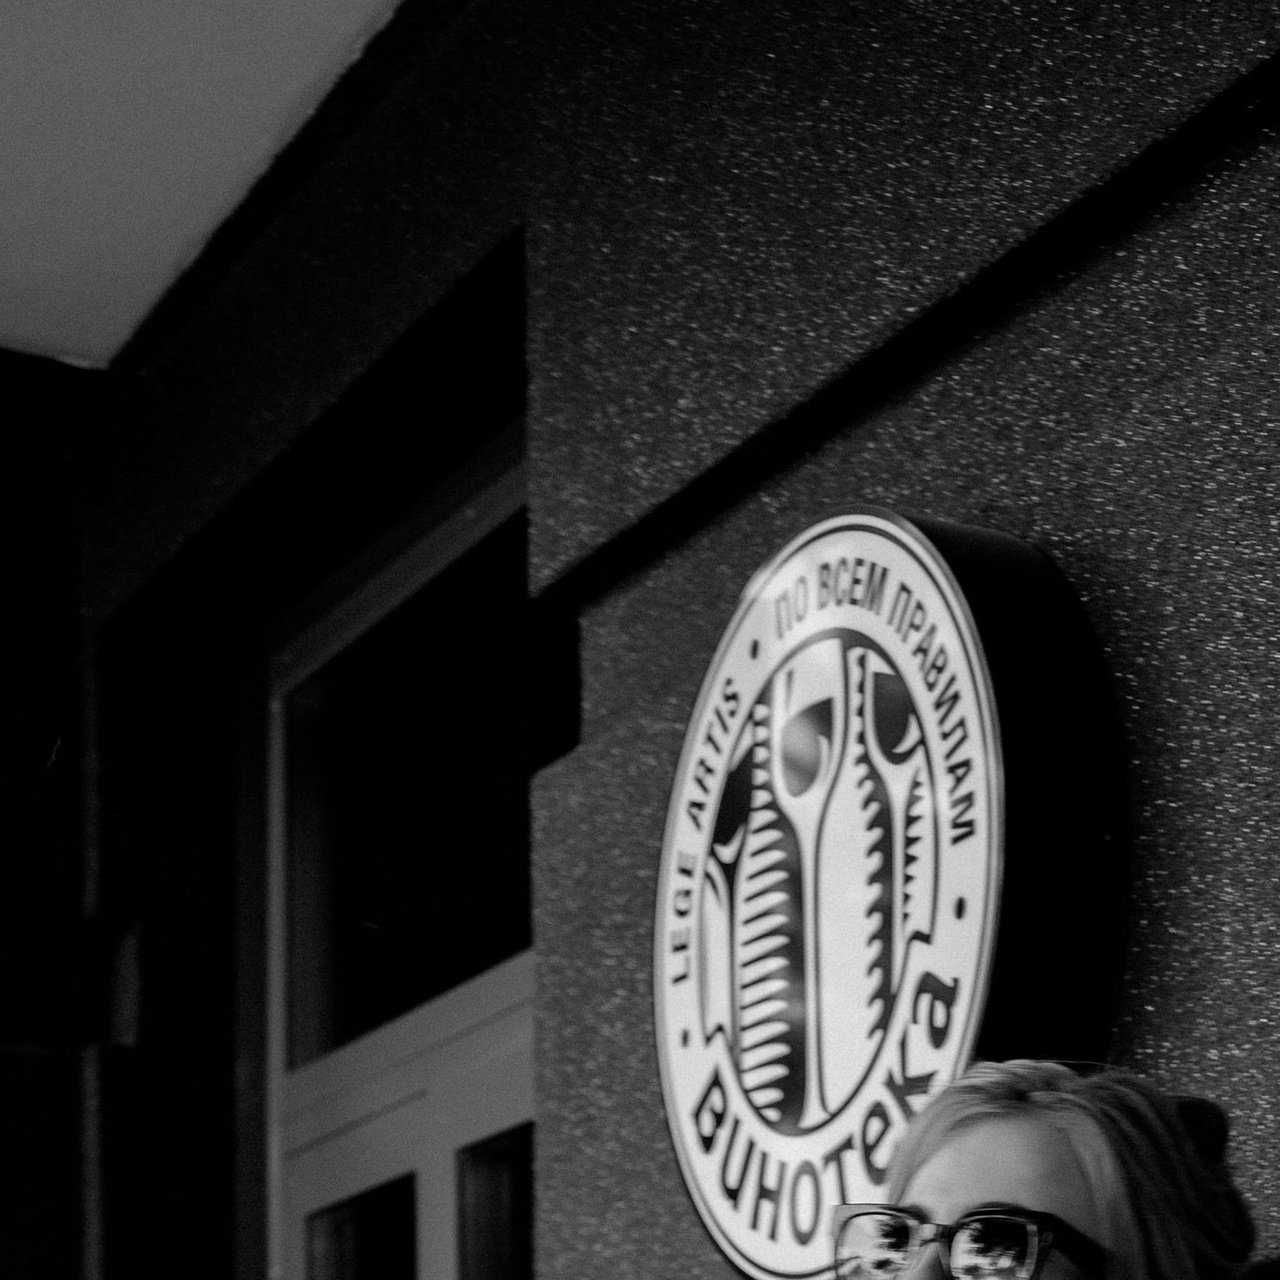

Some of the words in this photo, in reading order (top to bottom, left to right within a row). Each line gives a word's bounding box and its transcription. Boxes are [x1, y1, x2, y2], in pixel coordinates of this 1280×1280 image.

[670, 851, 698, 985] LEGE
[686, 676, 739, 833] ARTIS
[773, 574, 810, 641] ПО
[816, 556, 890, 617] ВСЕМ
[887, 581, 976, 847] ПРАВИЛАМ
